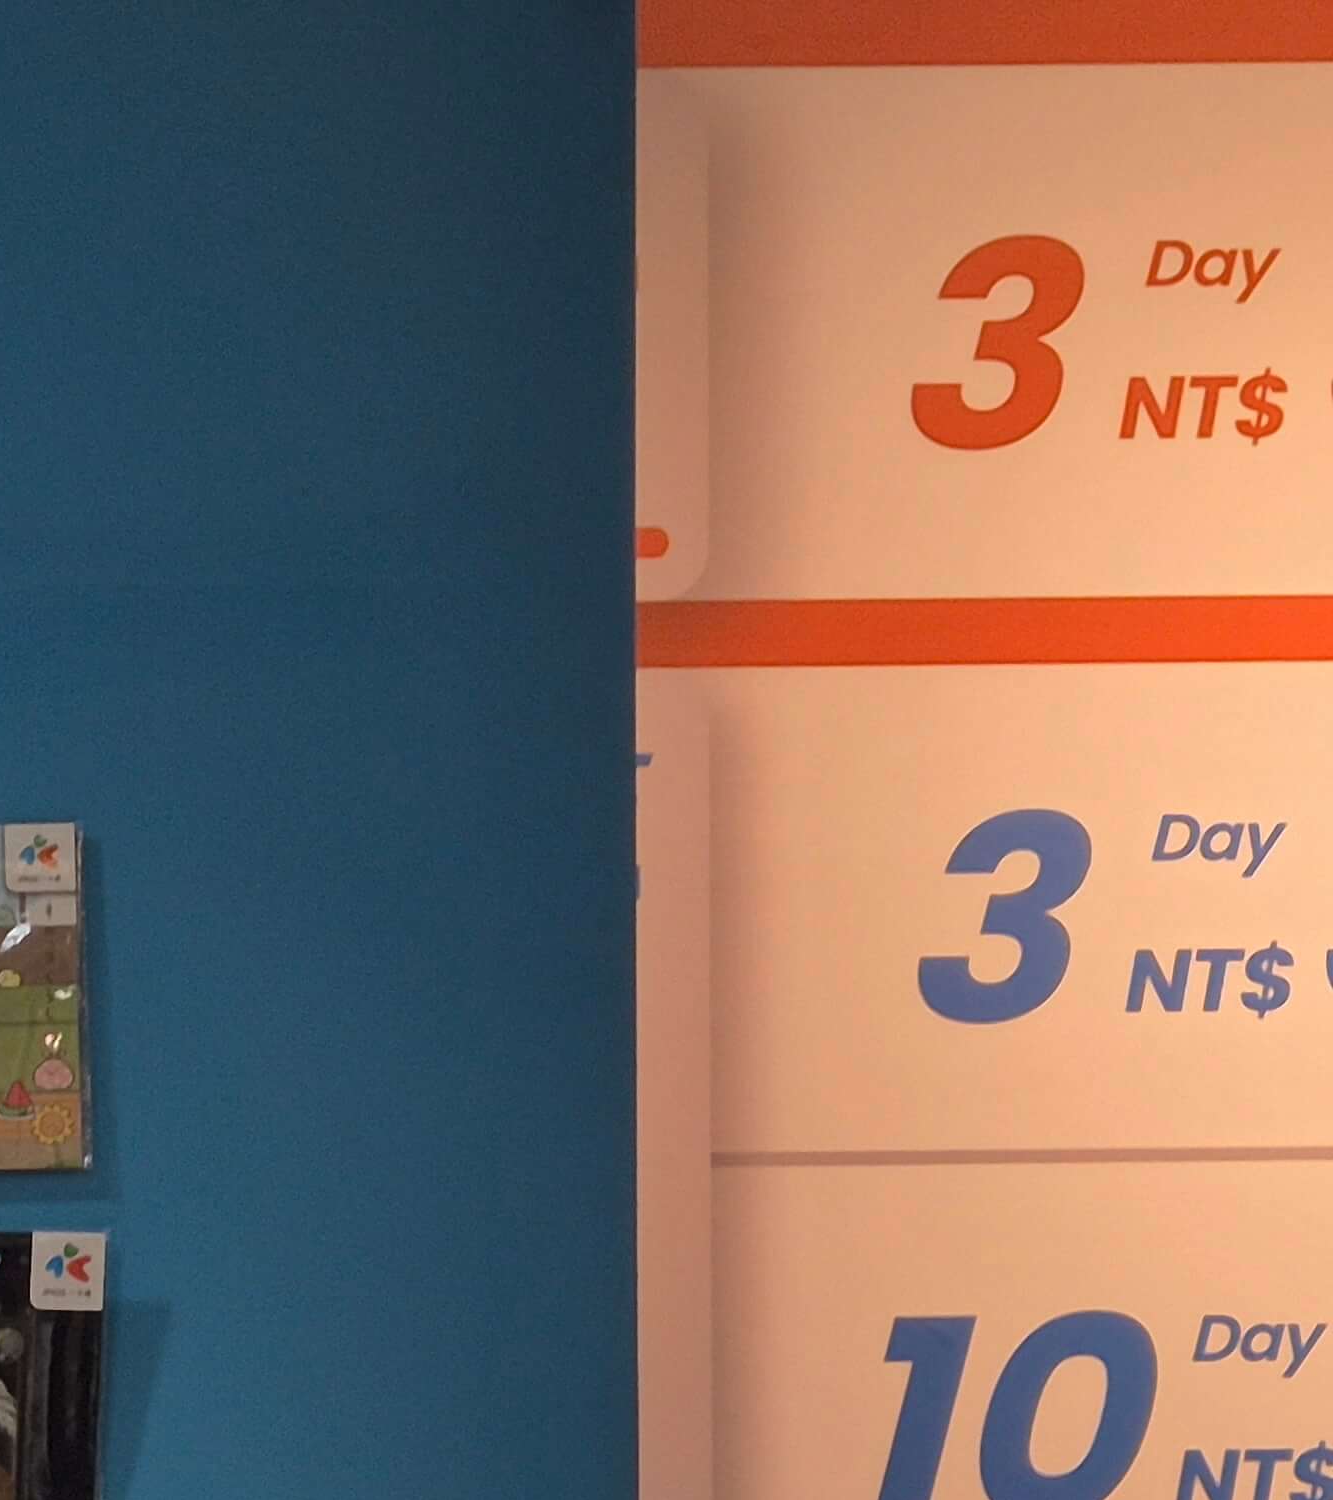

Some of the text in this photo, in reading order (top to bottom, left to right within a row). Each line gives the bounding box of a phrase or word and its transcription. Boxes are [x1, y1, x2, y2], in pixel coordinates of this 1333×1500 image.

[1145, 239, 1283, 305] Day
[911, 233, 1085, 452] 3
[1119, 366, 1288, 447] NT$
[1151, 814, 1288, 878] Day
[917, 808, 1093, 1025] 3
[1125, 940, 1295, 1020] NT$
[1193, 1314, 1328, 1379] Day
